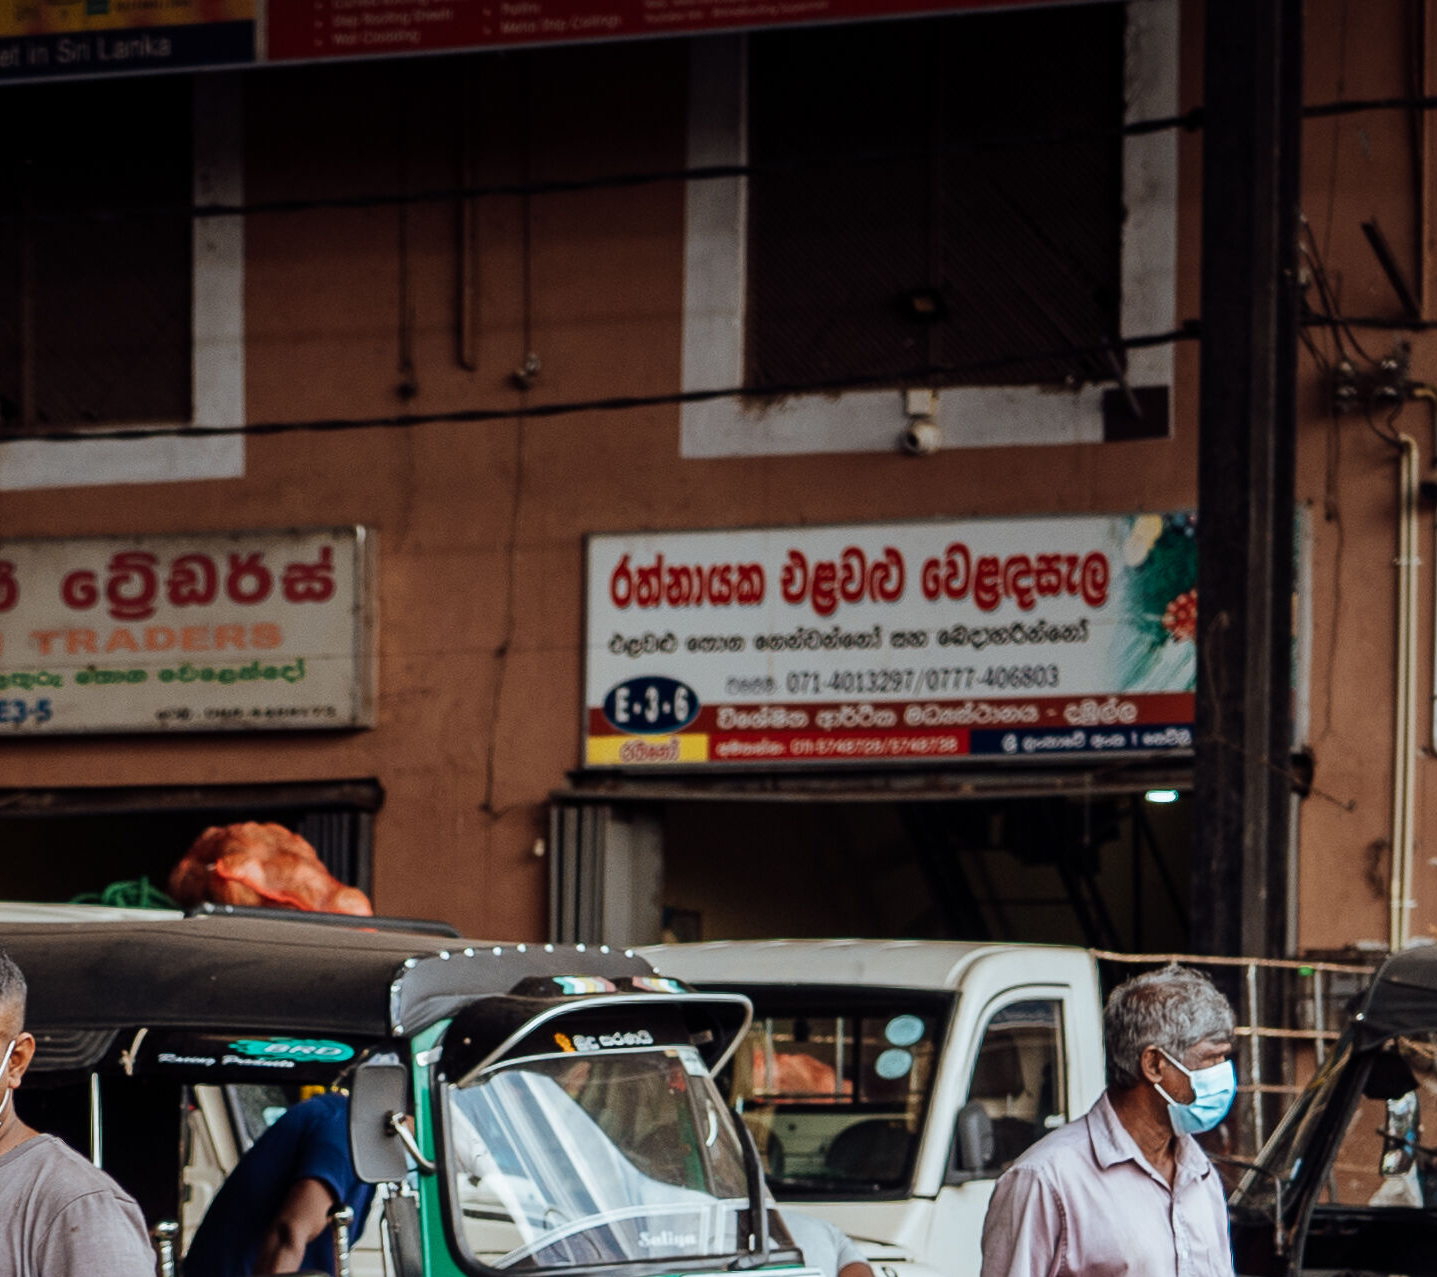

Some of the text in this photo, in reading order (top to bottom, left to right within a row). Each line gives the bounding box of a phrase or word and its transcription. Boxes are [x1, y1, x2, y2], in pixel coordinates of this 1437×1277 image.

[28, 39, 50, 65] in
[56, 36, 92, 64] Sri
[97, 31, 174, 60] Lanka
[60, 545, 337, 622] ට්‍රේඩර්ස්
[610, 541, 1110, 617] රත්නායක එළවළු වෙළඳසැල
[30, 621, 283, 655] TRADERS
[221, 1053, 297, 1069] Products
